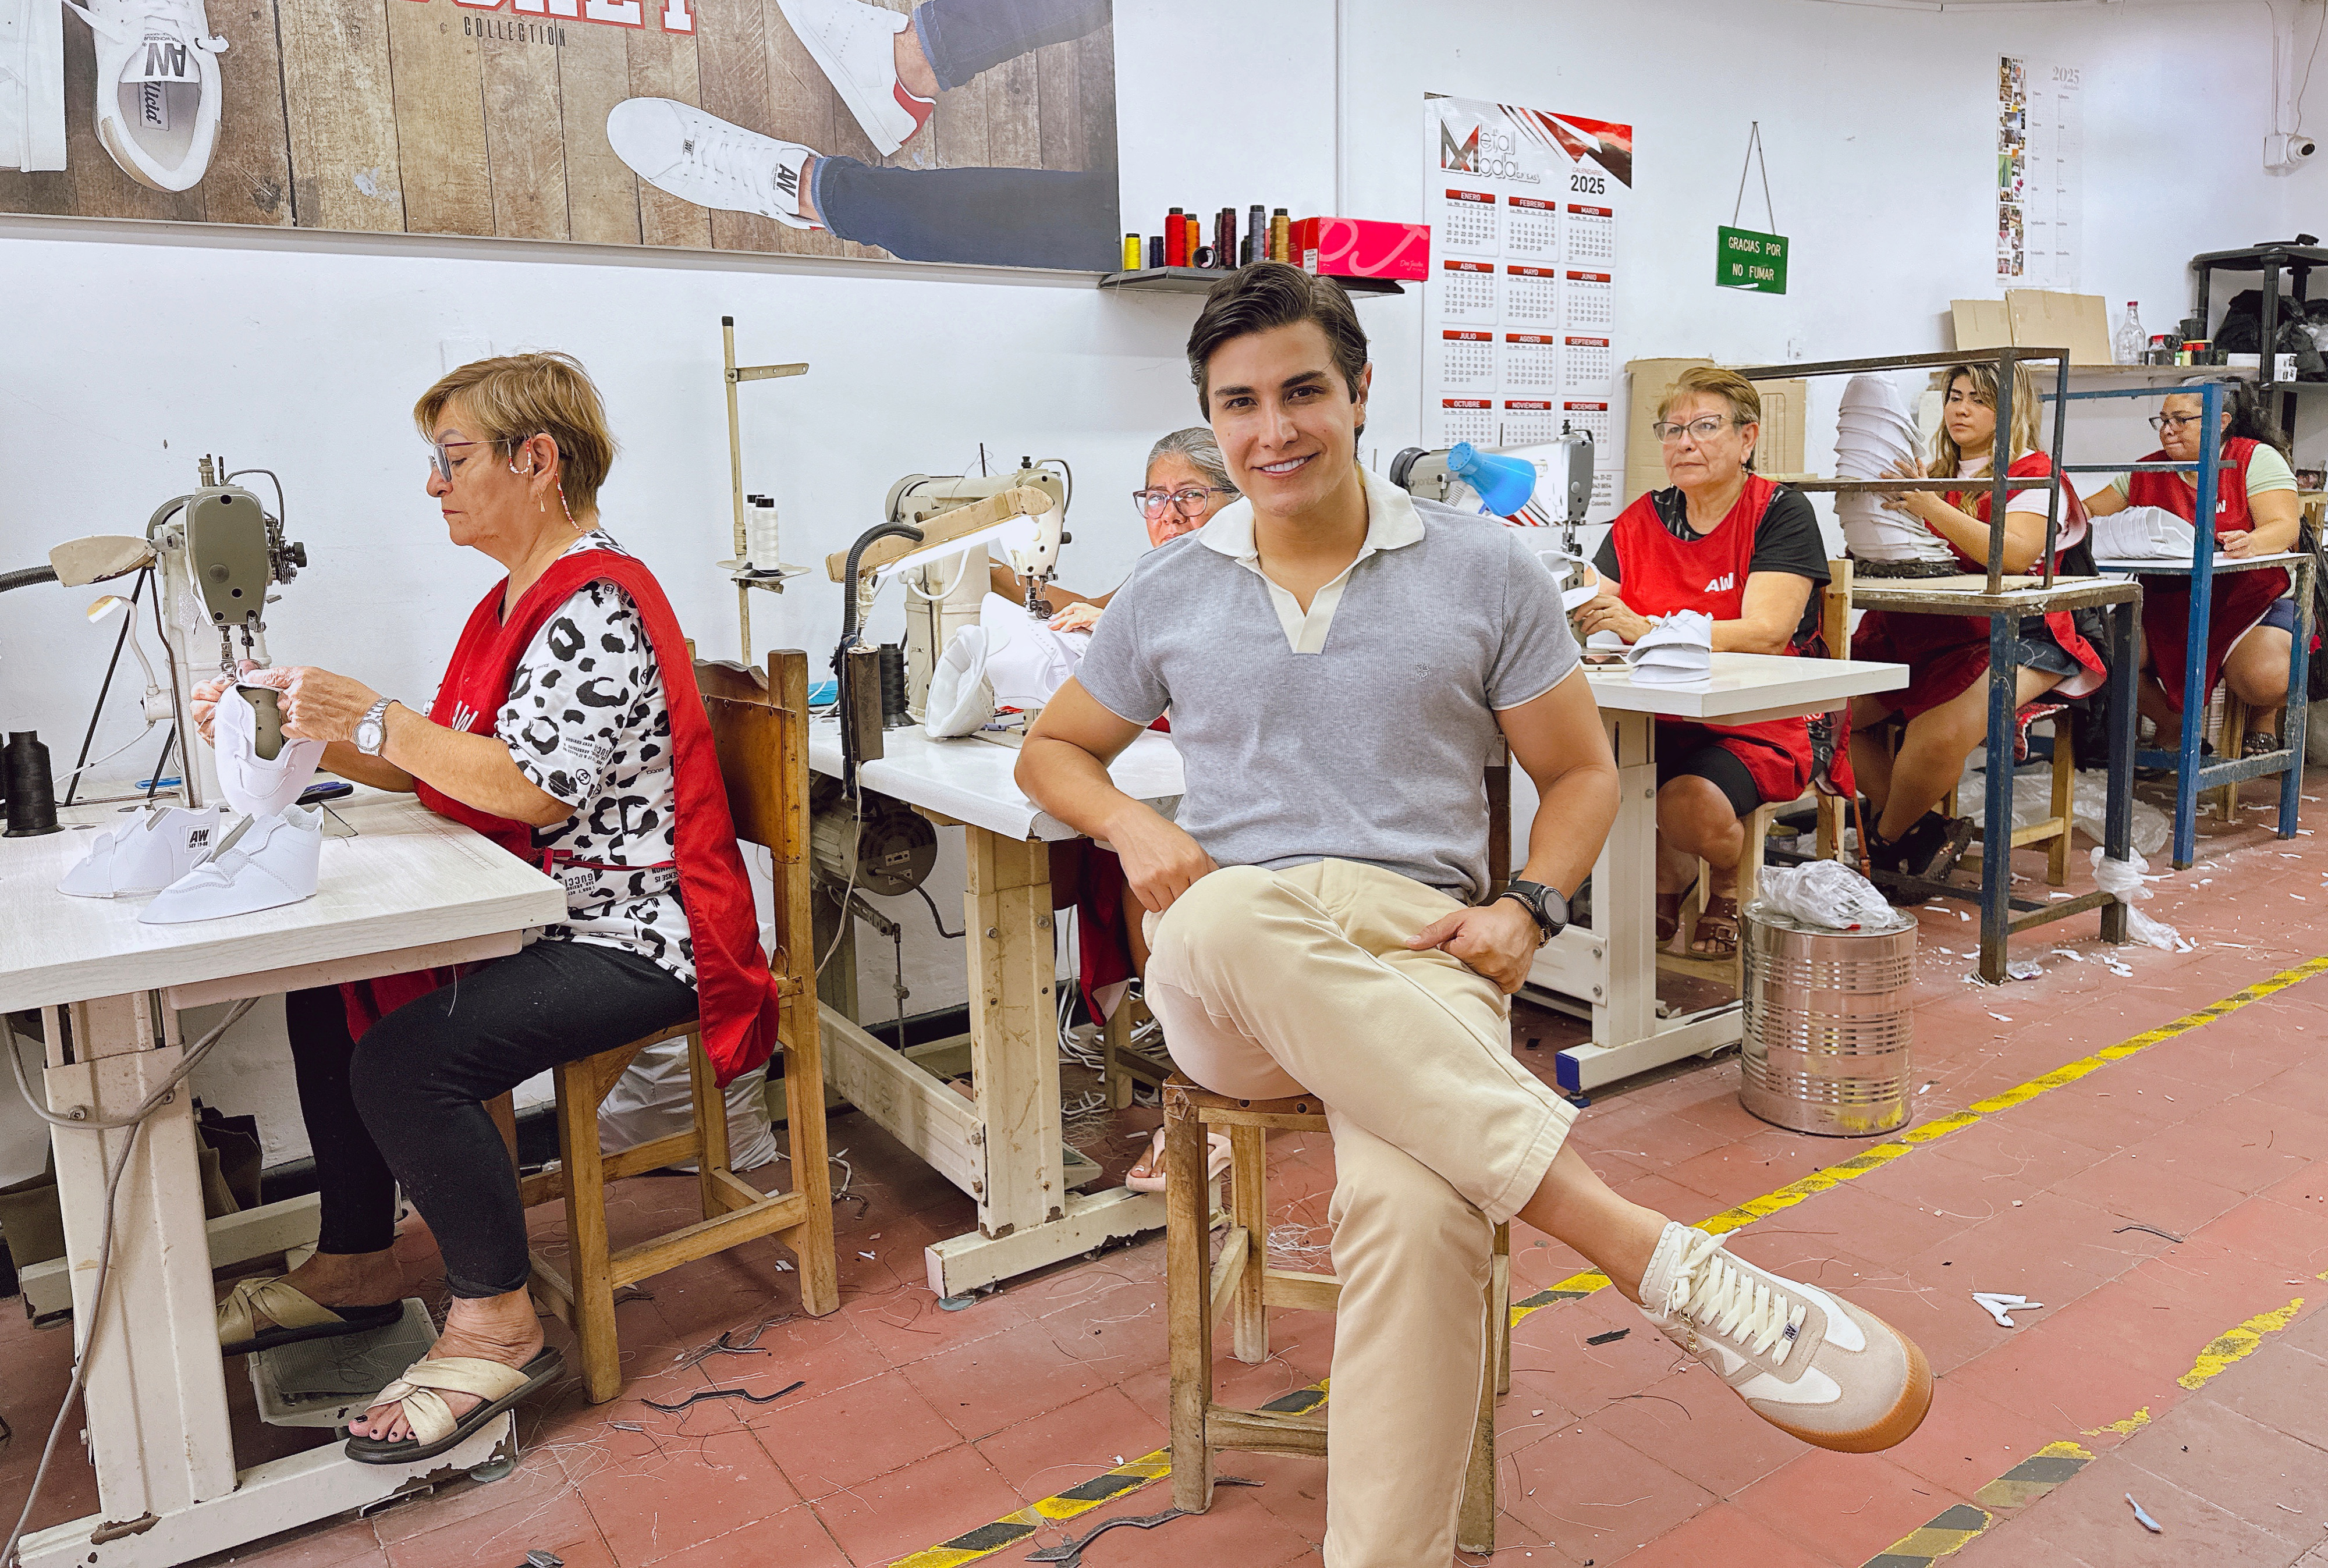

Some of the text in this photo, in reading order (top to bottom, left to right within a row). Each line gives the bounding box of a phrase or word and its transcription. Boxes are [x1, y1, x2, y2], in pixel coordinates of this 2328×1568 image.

[463, 16, 566, 47] COLLECTION
[144, 42, 187, 77] AW
[2052, 66, 2079, 84] 2025
[776, 163, 797, 198] AW
[1571, 175, 1605, 194] 2025
[1461, 193, 1481, 201] ENERO
[1520, 200, 1545, 208] FEBRERO
[1581, 207, 1599, 215] MARZO
[1728, 237, 1781, 257] GRACIAS POR
[1460, 263, 1478, 271] ABRIL
[1732, 263, 1775, 280] NO FUMAR
[1518, 335, 1541, 343] AGOSTO
[2216, 499, 2226, 513] W
[1704, 572, 1734, 592] AW
[189, 829, 210, 843] AW
[565, 873, 594, 887] GUCCI
[1785, 1325, 1797, 1339] AW
